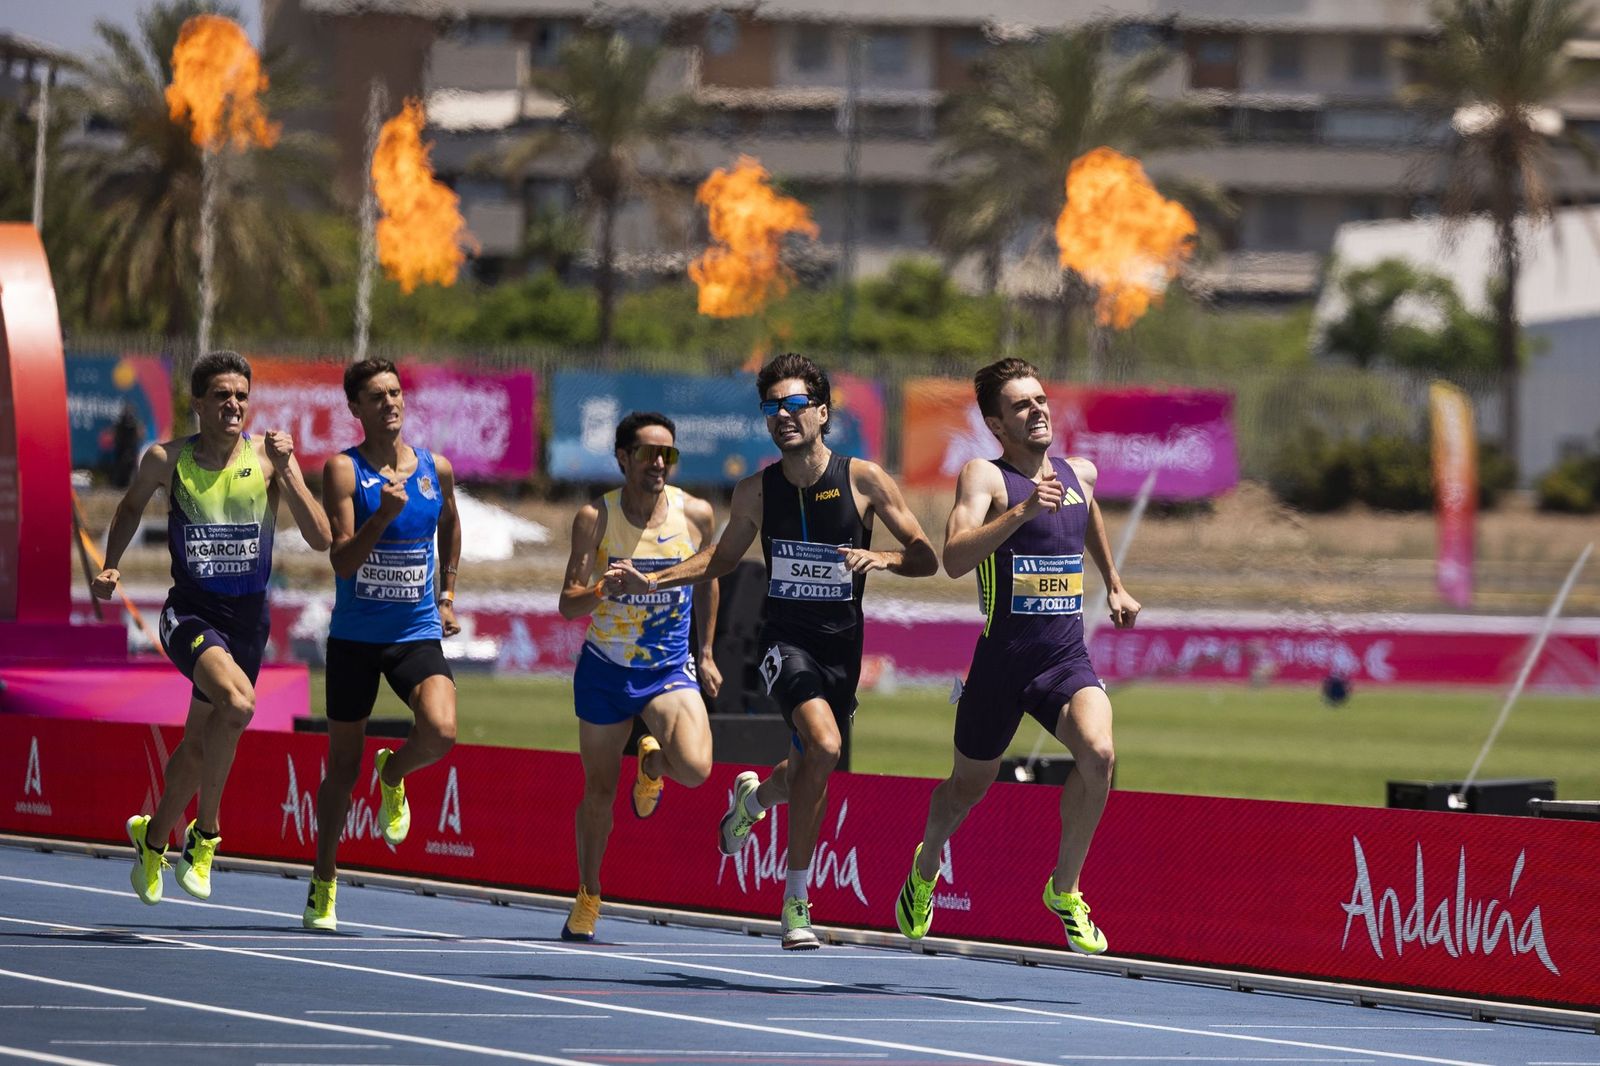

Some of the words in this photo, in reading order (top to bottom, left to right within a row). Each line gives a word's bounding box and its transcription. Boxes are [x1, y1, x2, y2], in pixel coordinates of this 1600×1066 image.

[816, 488, 840, 501] HOKA
[796, 544, 824, 554] Diputación
[362, 567, 424, 583] SEGUROLA
[790, 563, 833, 579] SAEZ
[1039, 578, 1068, 592] BEN
[1340, 834, 1561, 977] Andalucía
